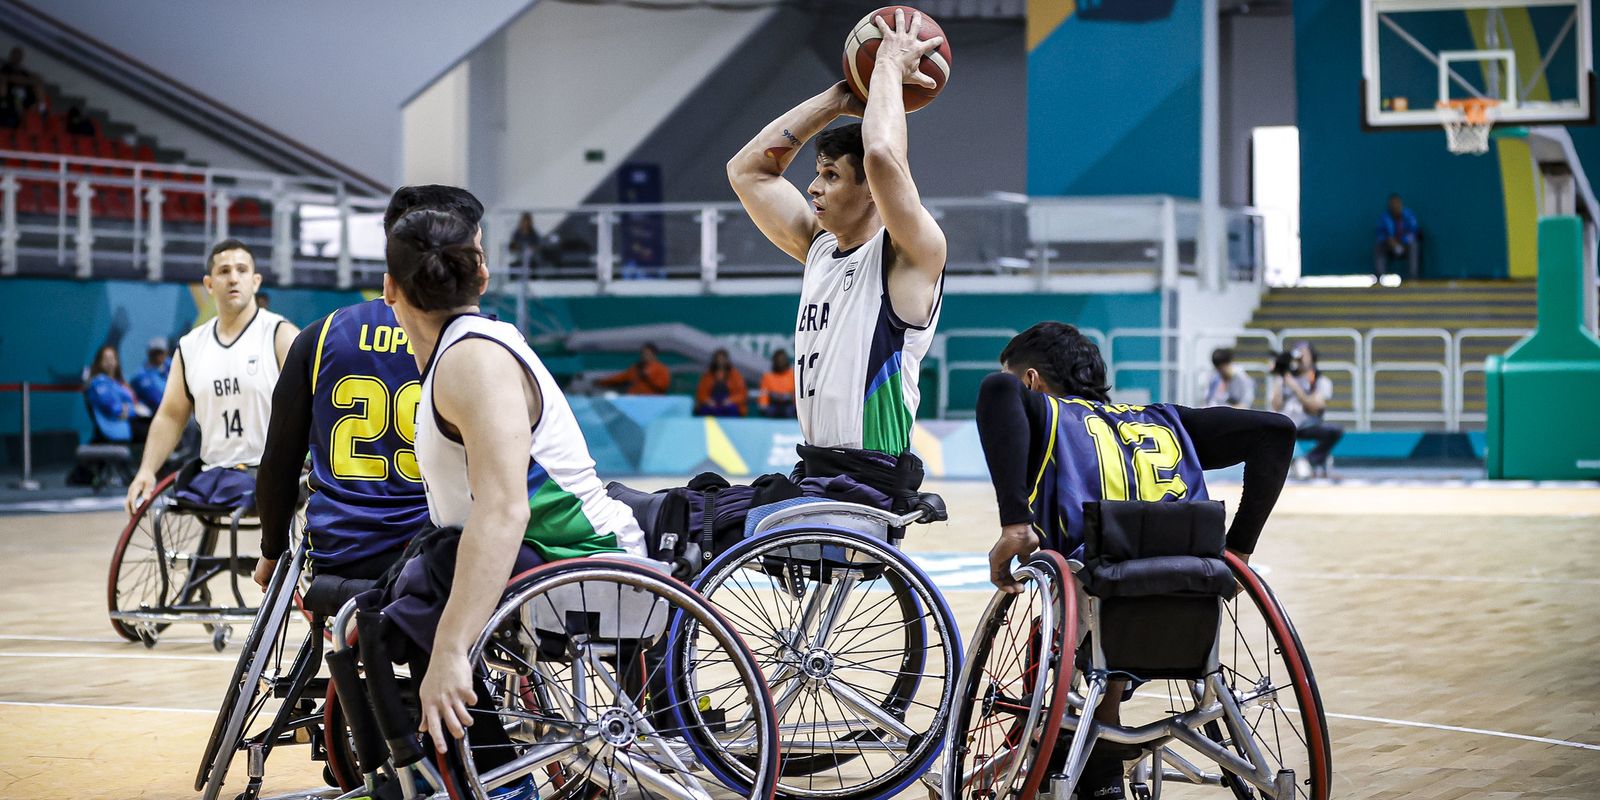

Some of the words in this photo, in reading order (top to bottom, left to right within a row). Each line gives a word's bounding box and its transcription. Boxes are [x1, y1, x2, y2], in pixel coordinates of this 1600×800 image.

[213, 377, 241, 397] BRA
[222, 409, 243, 439] 14
[330, 374, 424, 483] 29
[1084, 415, 1188, 502] 12
